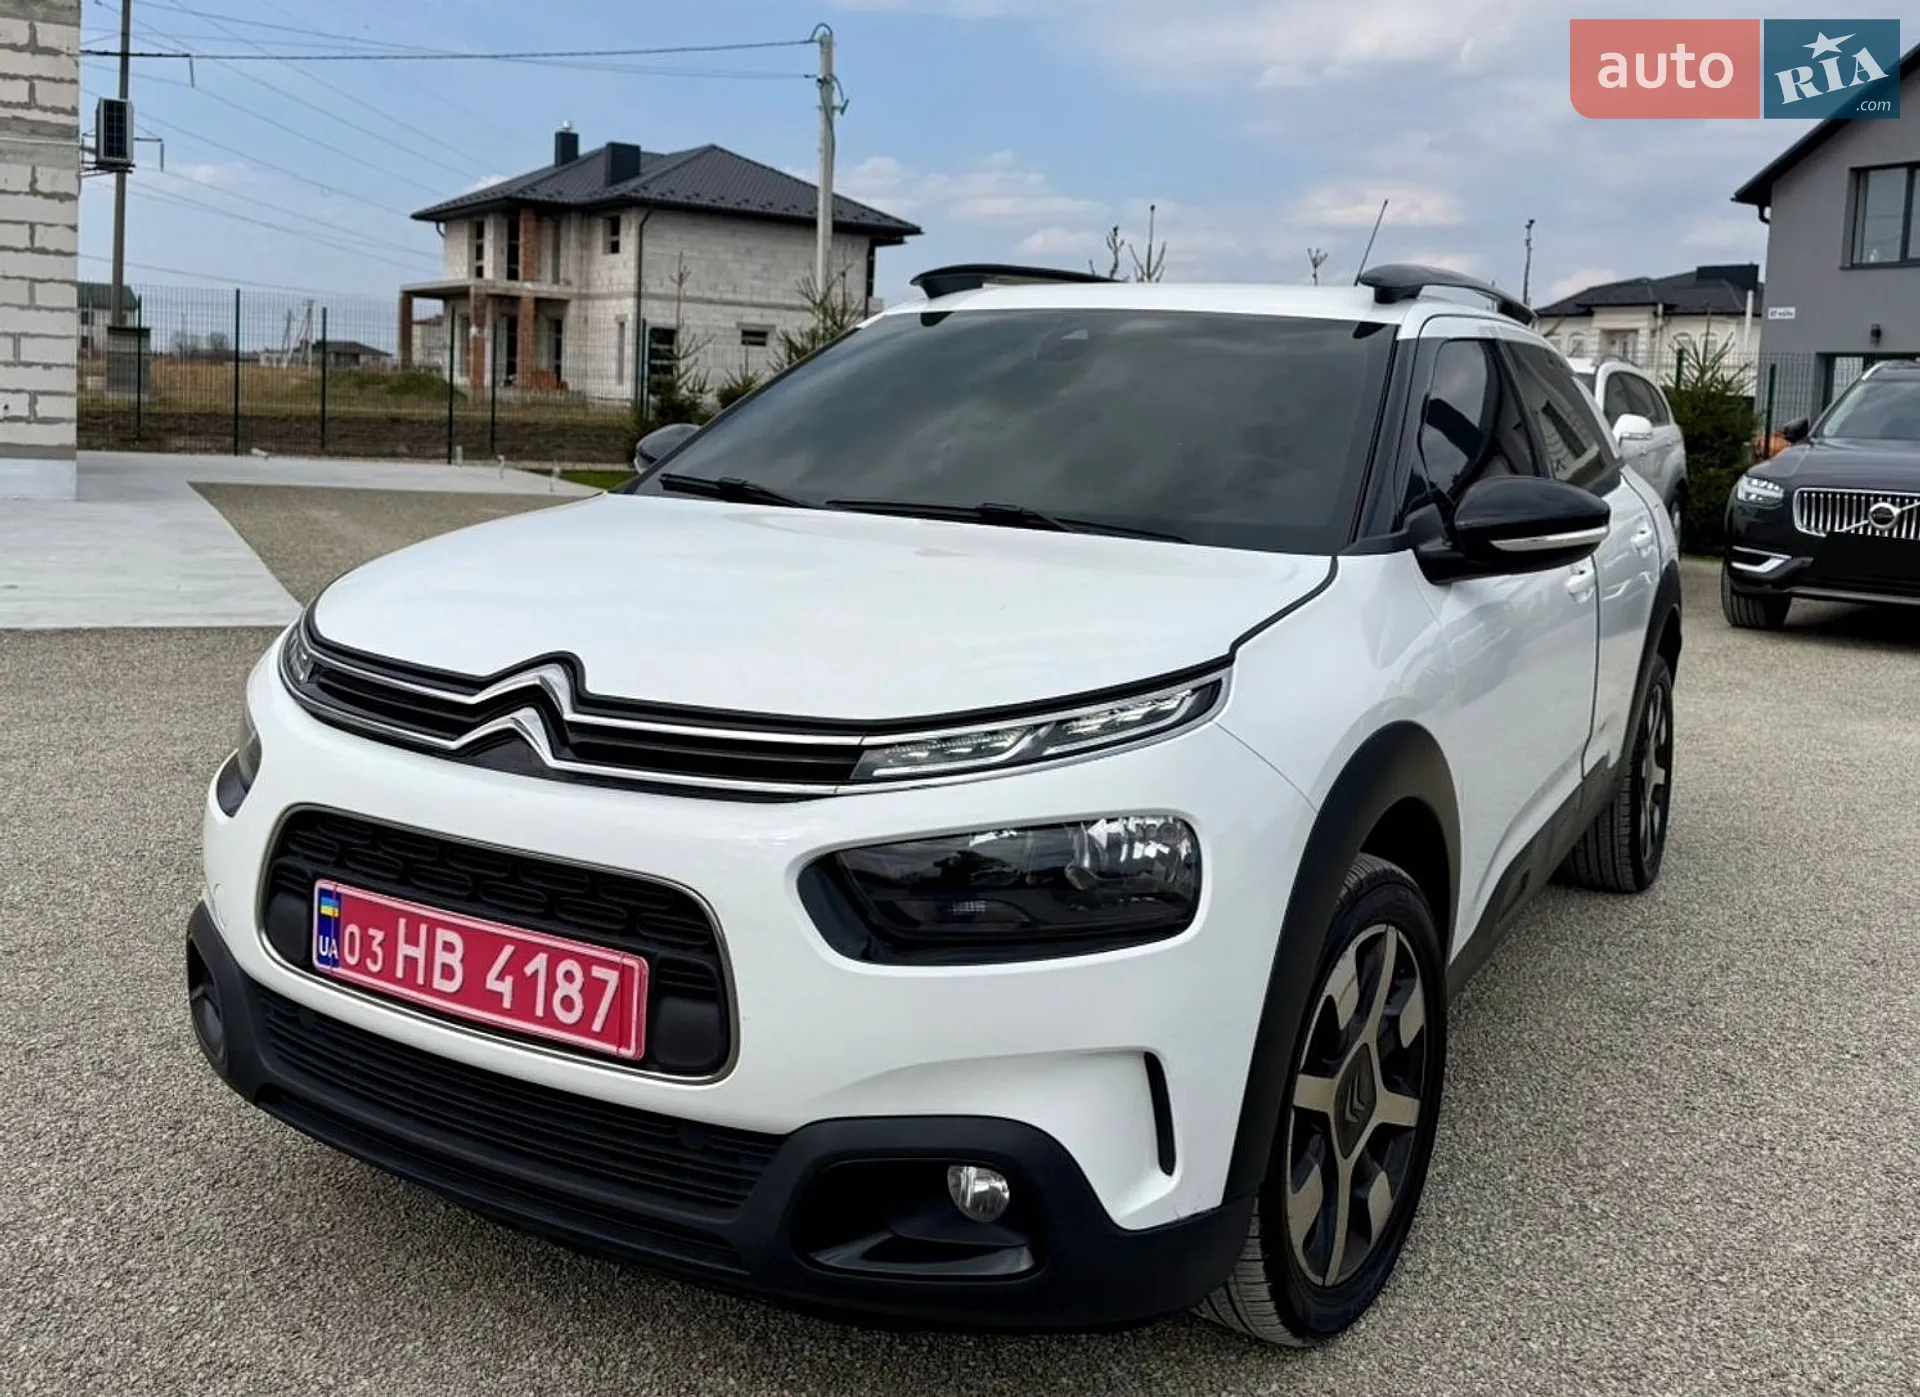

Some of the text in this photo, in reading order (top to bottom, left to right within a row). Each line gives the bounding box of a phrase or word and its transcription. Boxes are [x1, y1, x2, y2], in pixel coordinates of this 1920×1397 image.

[318, 935, 339, 960] UA
[343, 918, 620, 1033] 03 HB 4187
